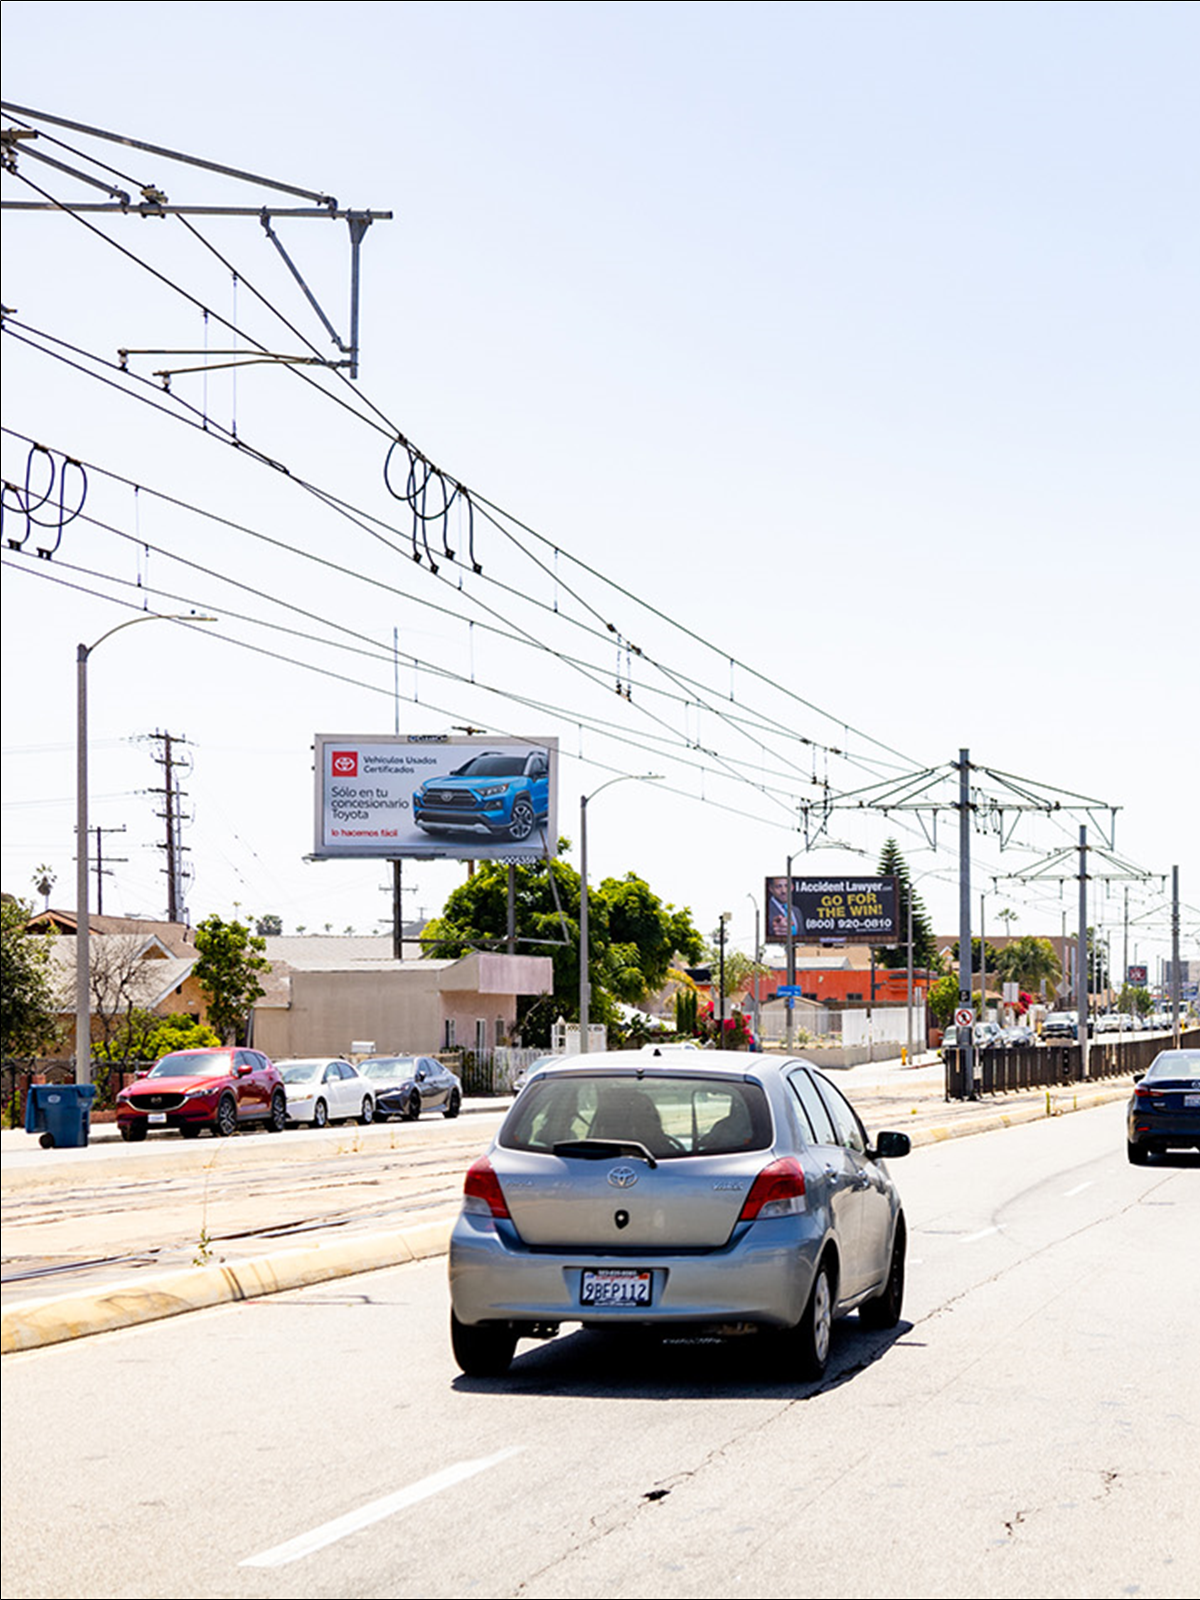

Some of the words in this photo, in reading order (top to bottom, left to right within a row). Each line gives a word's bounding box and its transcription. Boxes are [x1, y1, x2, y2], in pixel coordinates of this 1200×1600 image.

[406, 756, 437, 765] Usados
[363, 765, 415, 774] Certificados
[331, 786, 357, 798] Sólo
[359, 789, 374, 798] en
[376, 788, 388, 798] tu
[331, 798, 409, 809] concesionario
[332, 808, 369, 822] Toyota
[331, 829, 340, 837] lo
[341, 829, 379, 837] hacemos
[800, 881, 845, 892] Accident
[821, 895, 843, 907] GO
[847, 893, 877, 905] FOR
[816, 906, 846, 918] THE
[849, 904, 883, 916] WIN!
[805, 918, 835, 930] (800)
